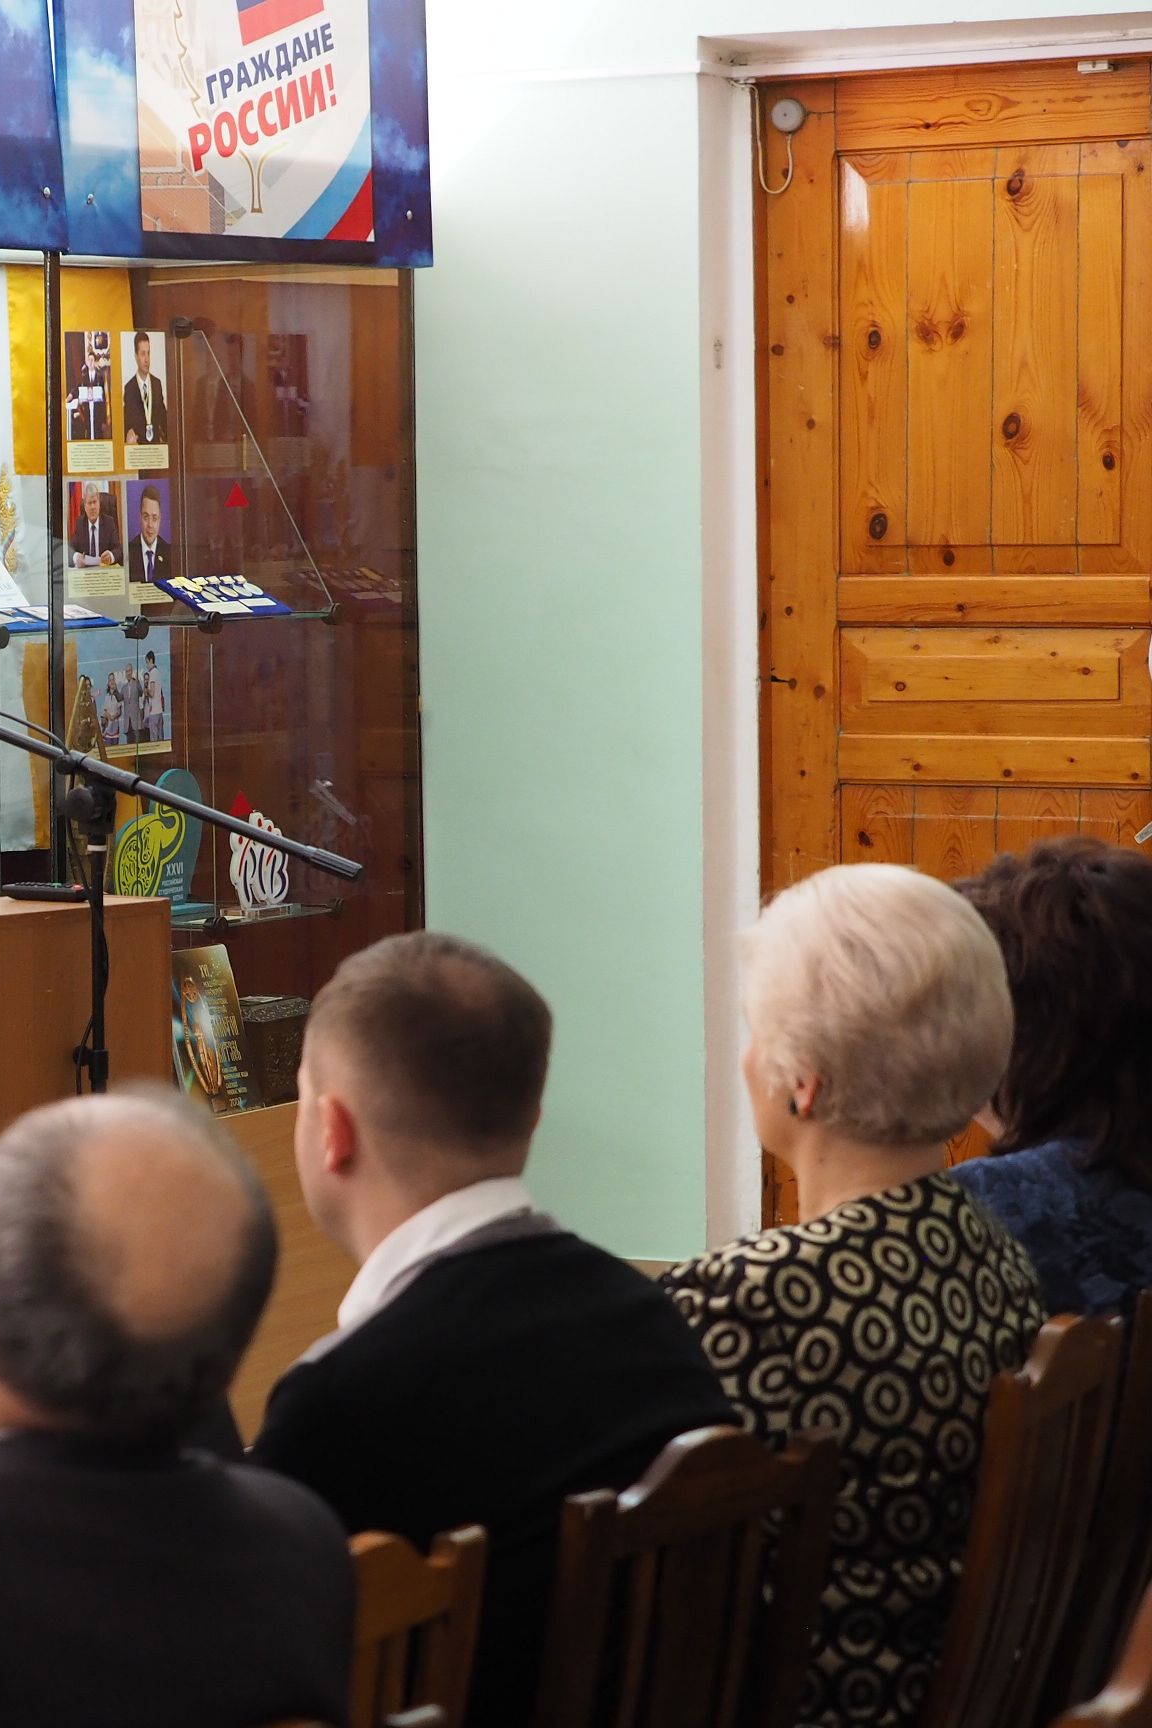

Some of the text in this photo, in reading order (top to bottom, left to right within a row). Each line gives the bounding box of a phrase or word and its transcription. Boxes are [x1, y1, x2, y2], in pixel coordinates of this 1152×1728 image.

[206, 23, 335, 105] ГРАЖДАНЕ
[188, 63, 337, 172] РОССИИ!
[165, 861, 185, 877] XXVI
